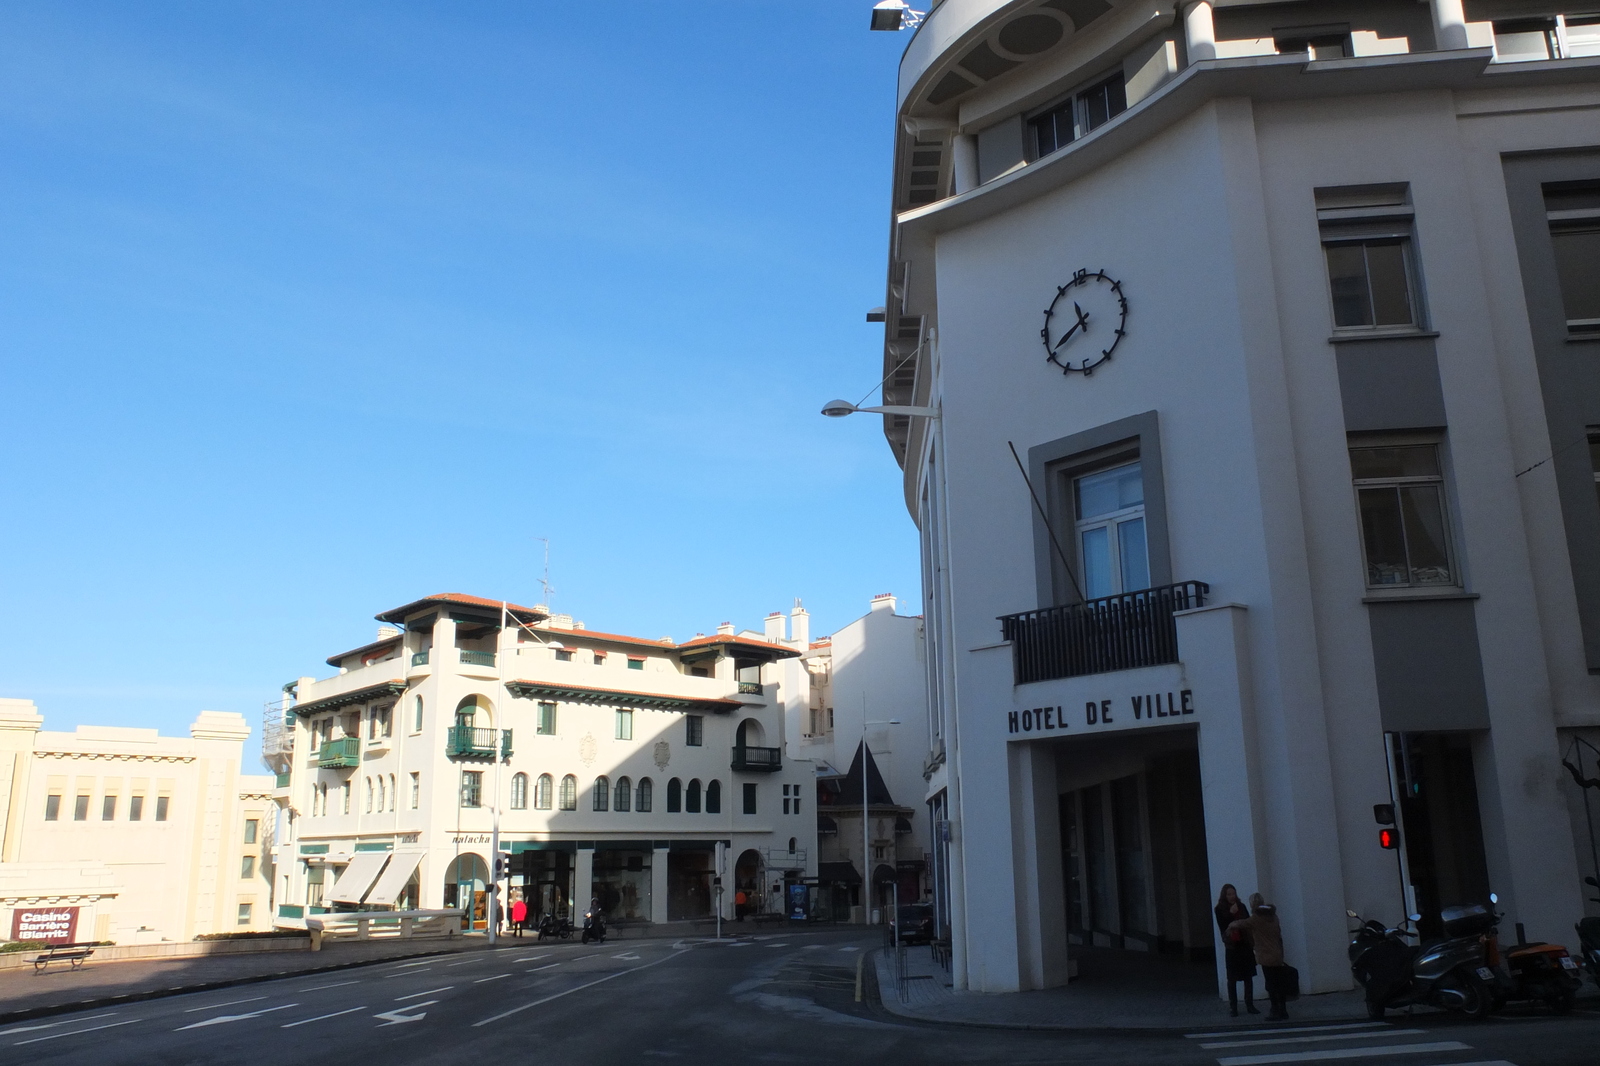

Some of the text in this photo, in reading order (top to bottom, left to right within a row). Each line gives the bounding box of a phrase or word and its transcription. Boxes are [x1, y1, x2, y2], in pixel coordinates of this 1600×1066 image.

[1073, 268, 1086, 287] 12
[1082, 358, 1092, 376] 6
[1008, 689, 1194, 733] HOTEL DE VILLE
[452, 834, 490, 844] natacha
[20, 912, 71, 922] Casino
[19, 922, 70, 930] Barrière
[22, 930, 68, 939] Biarritz
